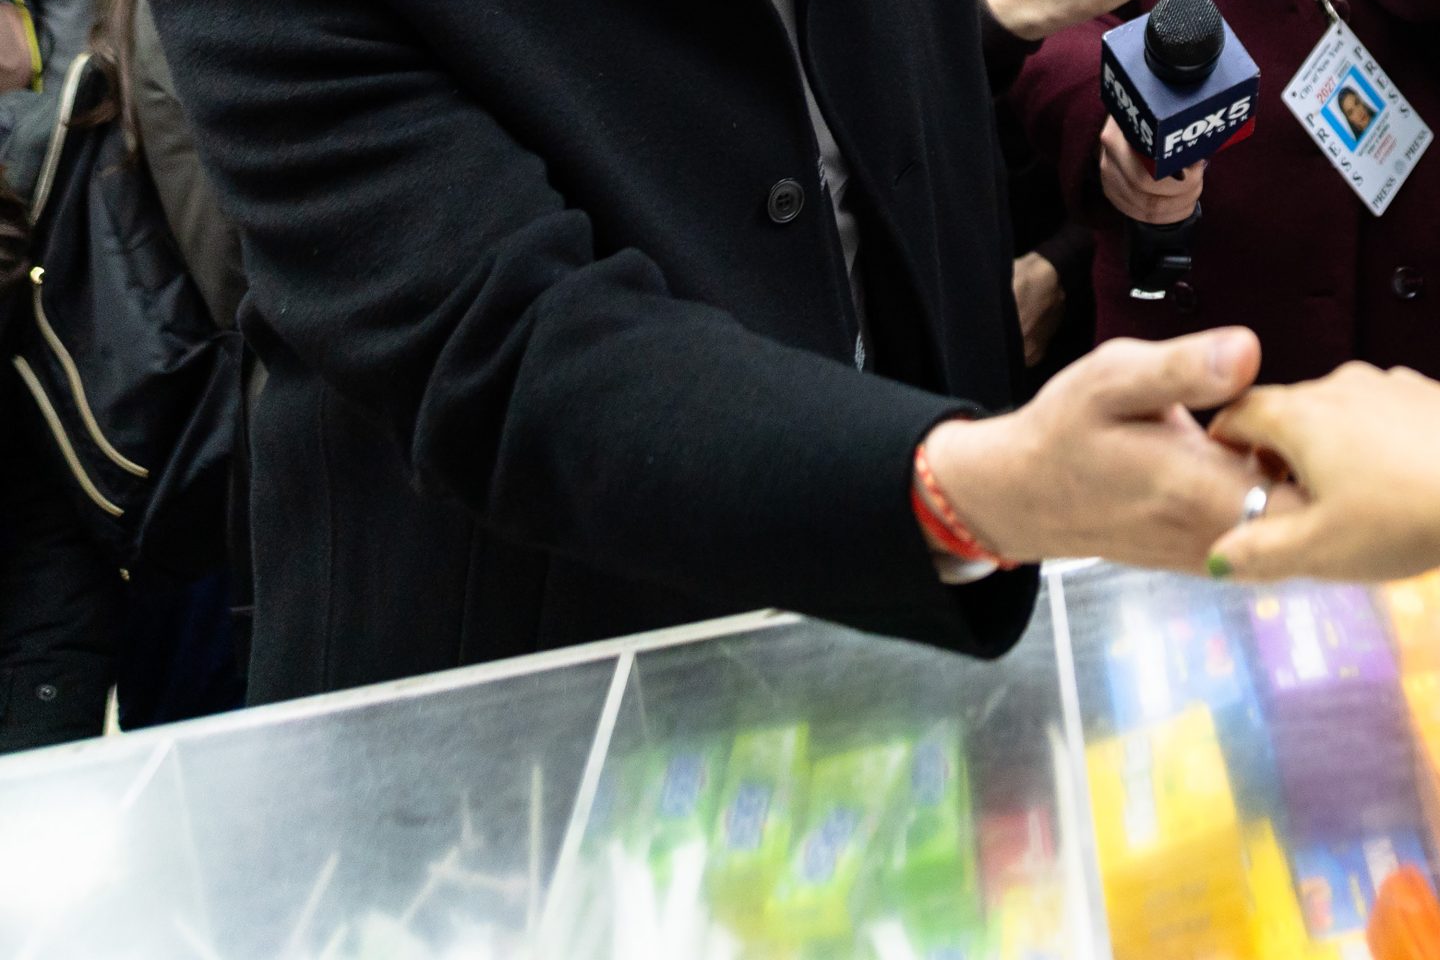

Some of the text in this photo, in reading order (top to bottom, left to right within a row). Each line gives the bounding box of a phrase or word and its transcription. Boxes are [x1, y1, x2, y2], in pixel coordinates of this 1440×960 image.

[1164, 108, 1227, 152] FOX
[1228, 96, 1251, 120] 5
[1164, 114, 1248, 159] NEW YORK
[1372, 175, 1397, 208] PRESS
[1404, 129, 1429, 161] PRESS
